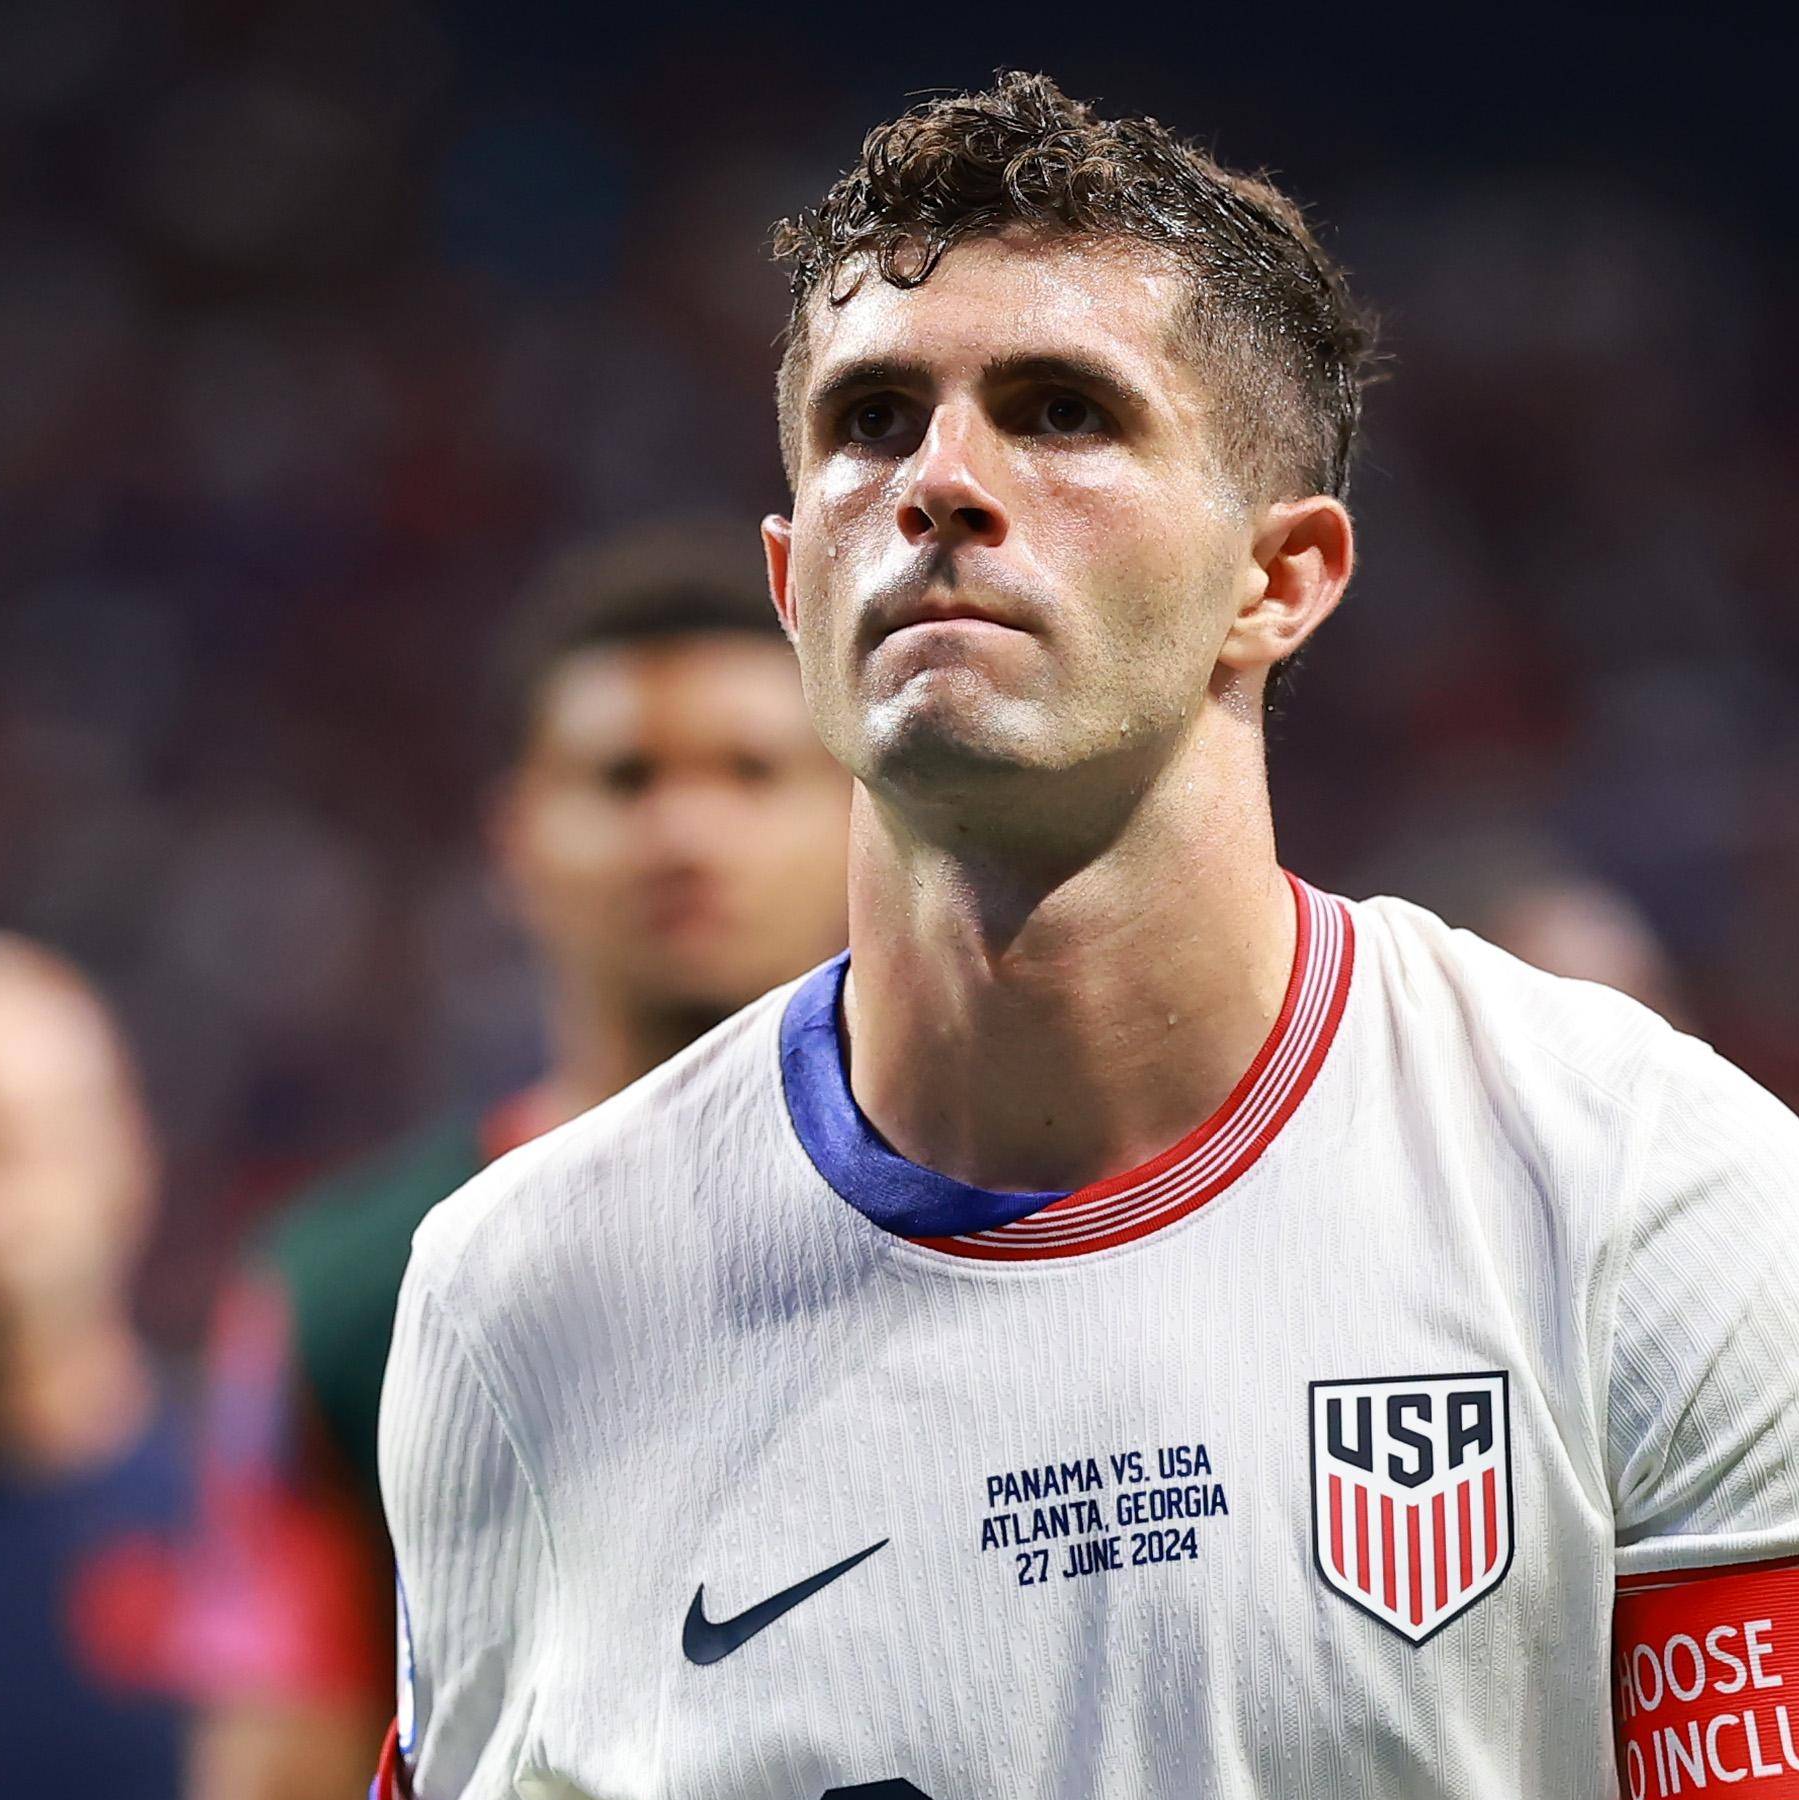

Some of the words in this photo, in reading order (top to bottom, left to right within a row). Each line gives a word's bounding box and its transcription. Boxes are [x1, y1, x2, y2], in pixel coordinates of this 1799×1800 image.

[1327, 1391, 1493, 1489] USA
[987, 1458, 1103, 1508] PANAMA
[1110, 1451, 1150, 1485] VS.
[1158, 1443, 1212, 1480] USA
[981, 1499, 1109, 1551] ATLANTA,
[1116, 1483, 1228, 1527] GEORGIA
[1016, 1549, 1049, 1586] 27
[1063, 1536, 1123, 1578] JUNE
[1131, 1527, 1198, 1565] 2024
[1618, 1618, 1783, 1721] HOOSE
